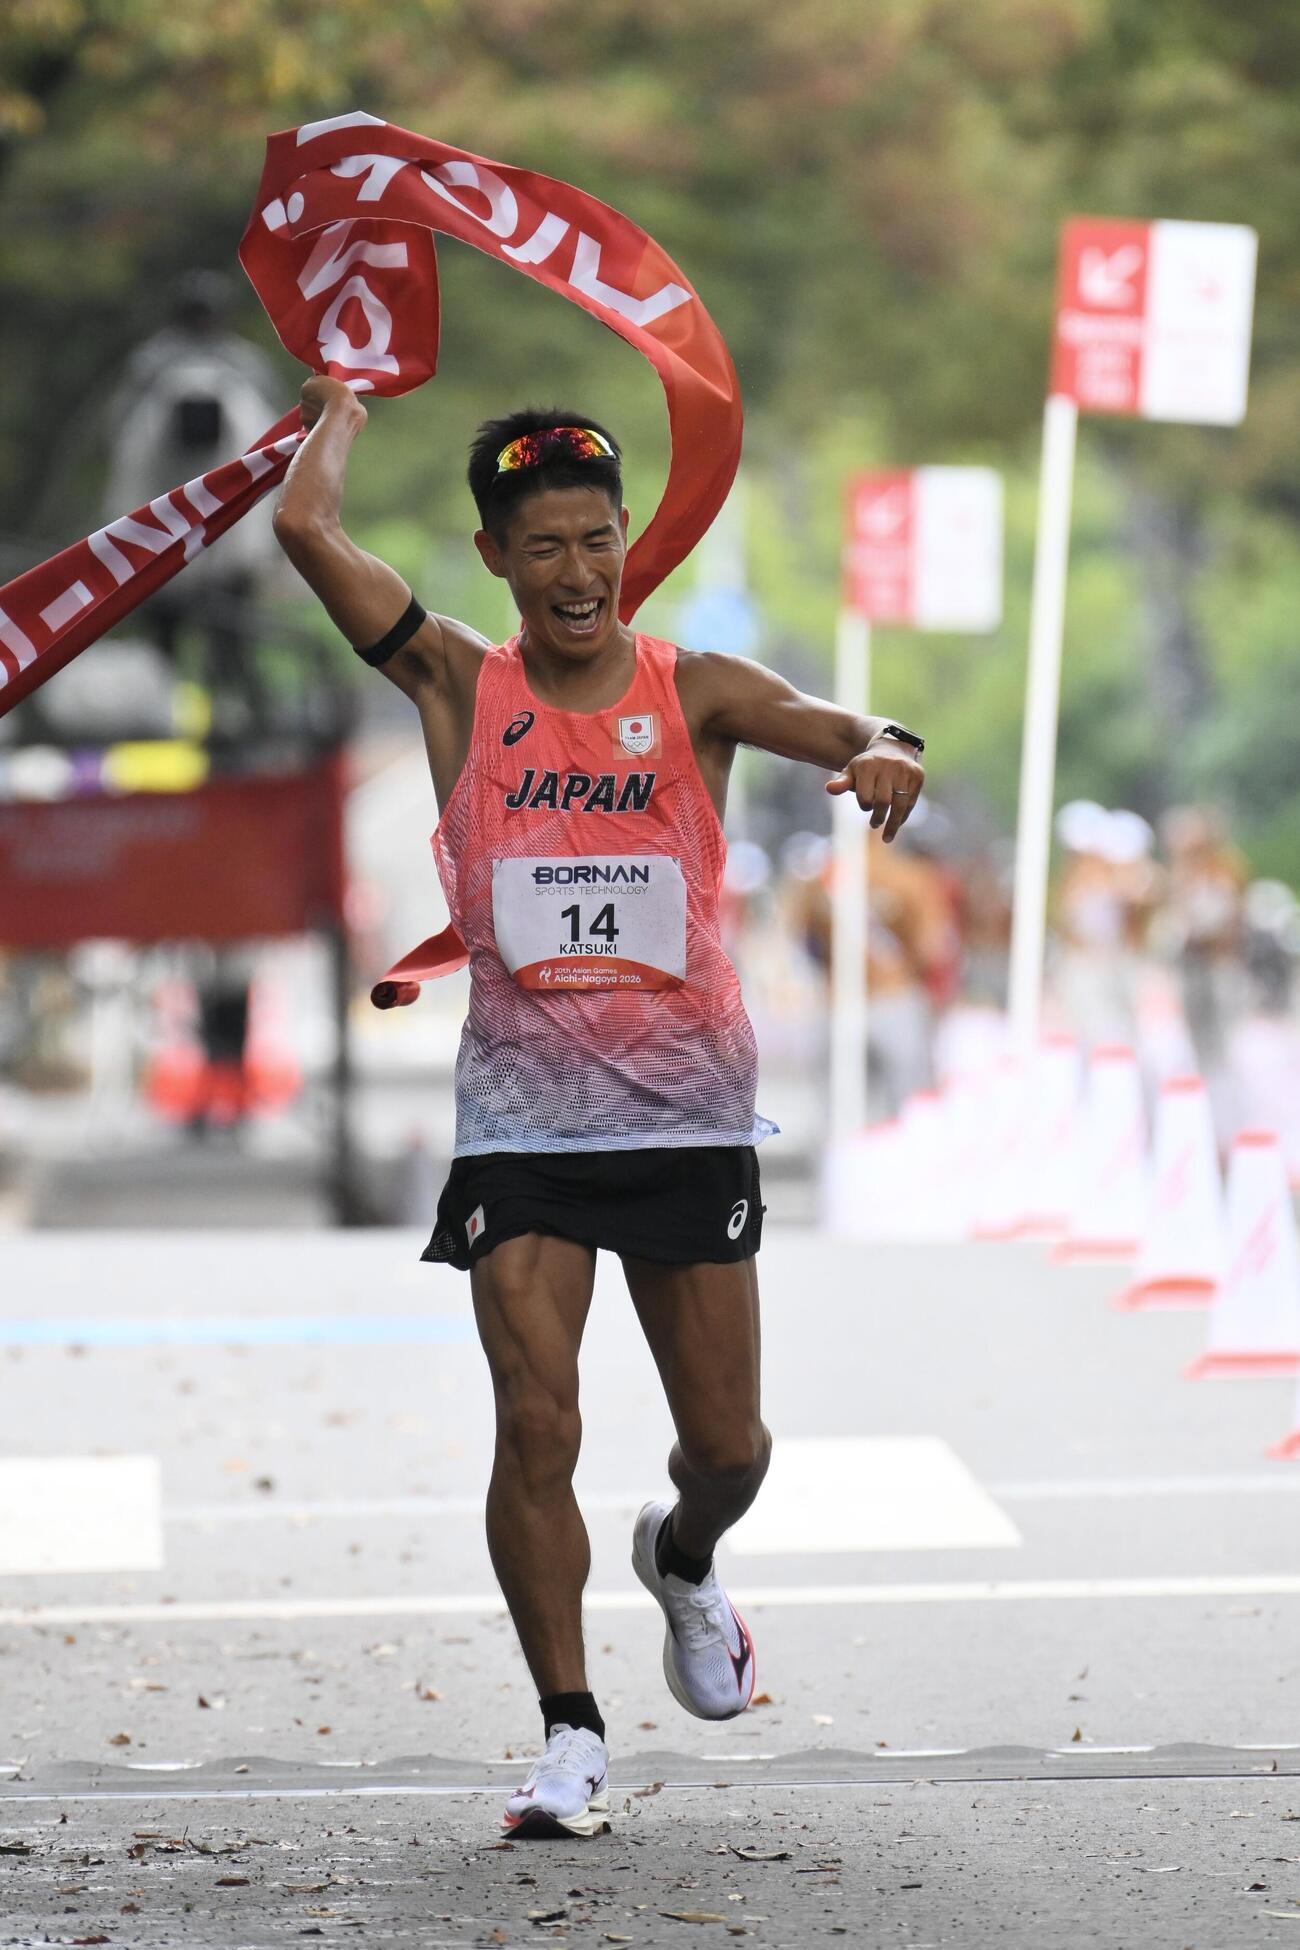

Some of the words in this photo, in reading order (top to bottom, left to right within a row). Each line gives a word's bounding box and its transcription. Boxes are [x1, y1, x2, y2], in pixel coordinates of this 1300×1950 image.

[505, 768, 656, 812] JAPAN
[531, 864, 649, 885] BORNAN
[535, 886, 575, 896] SPORTS
[579, 885, 649, 895] TECHNOLOGY
[561, 903, 619, 942] 14
[560, 943, 617, 955] KATSUKI
[554, 974, 617, 984] Aichi-Nagoya
[619, 975, 642, 984] 2026
